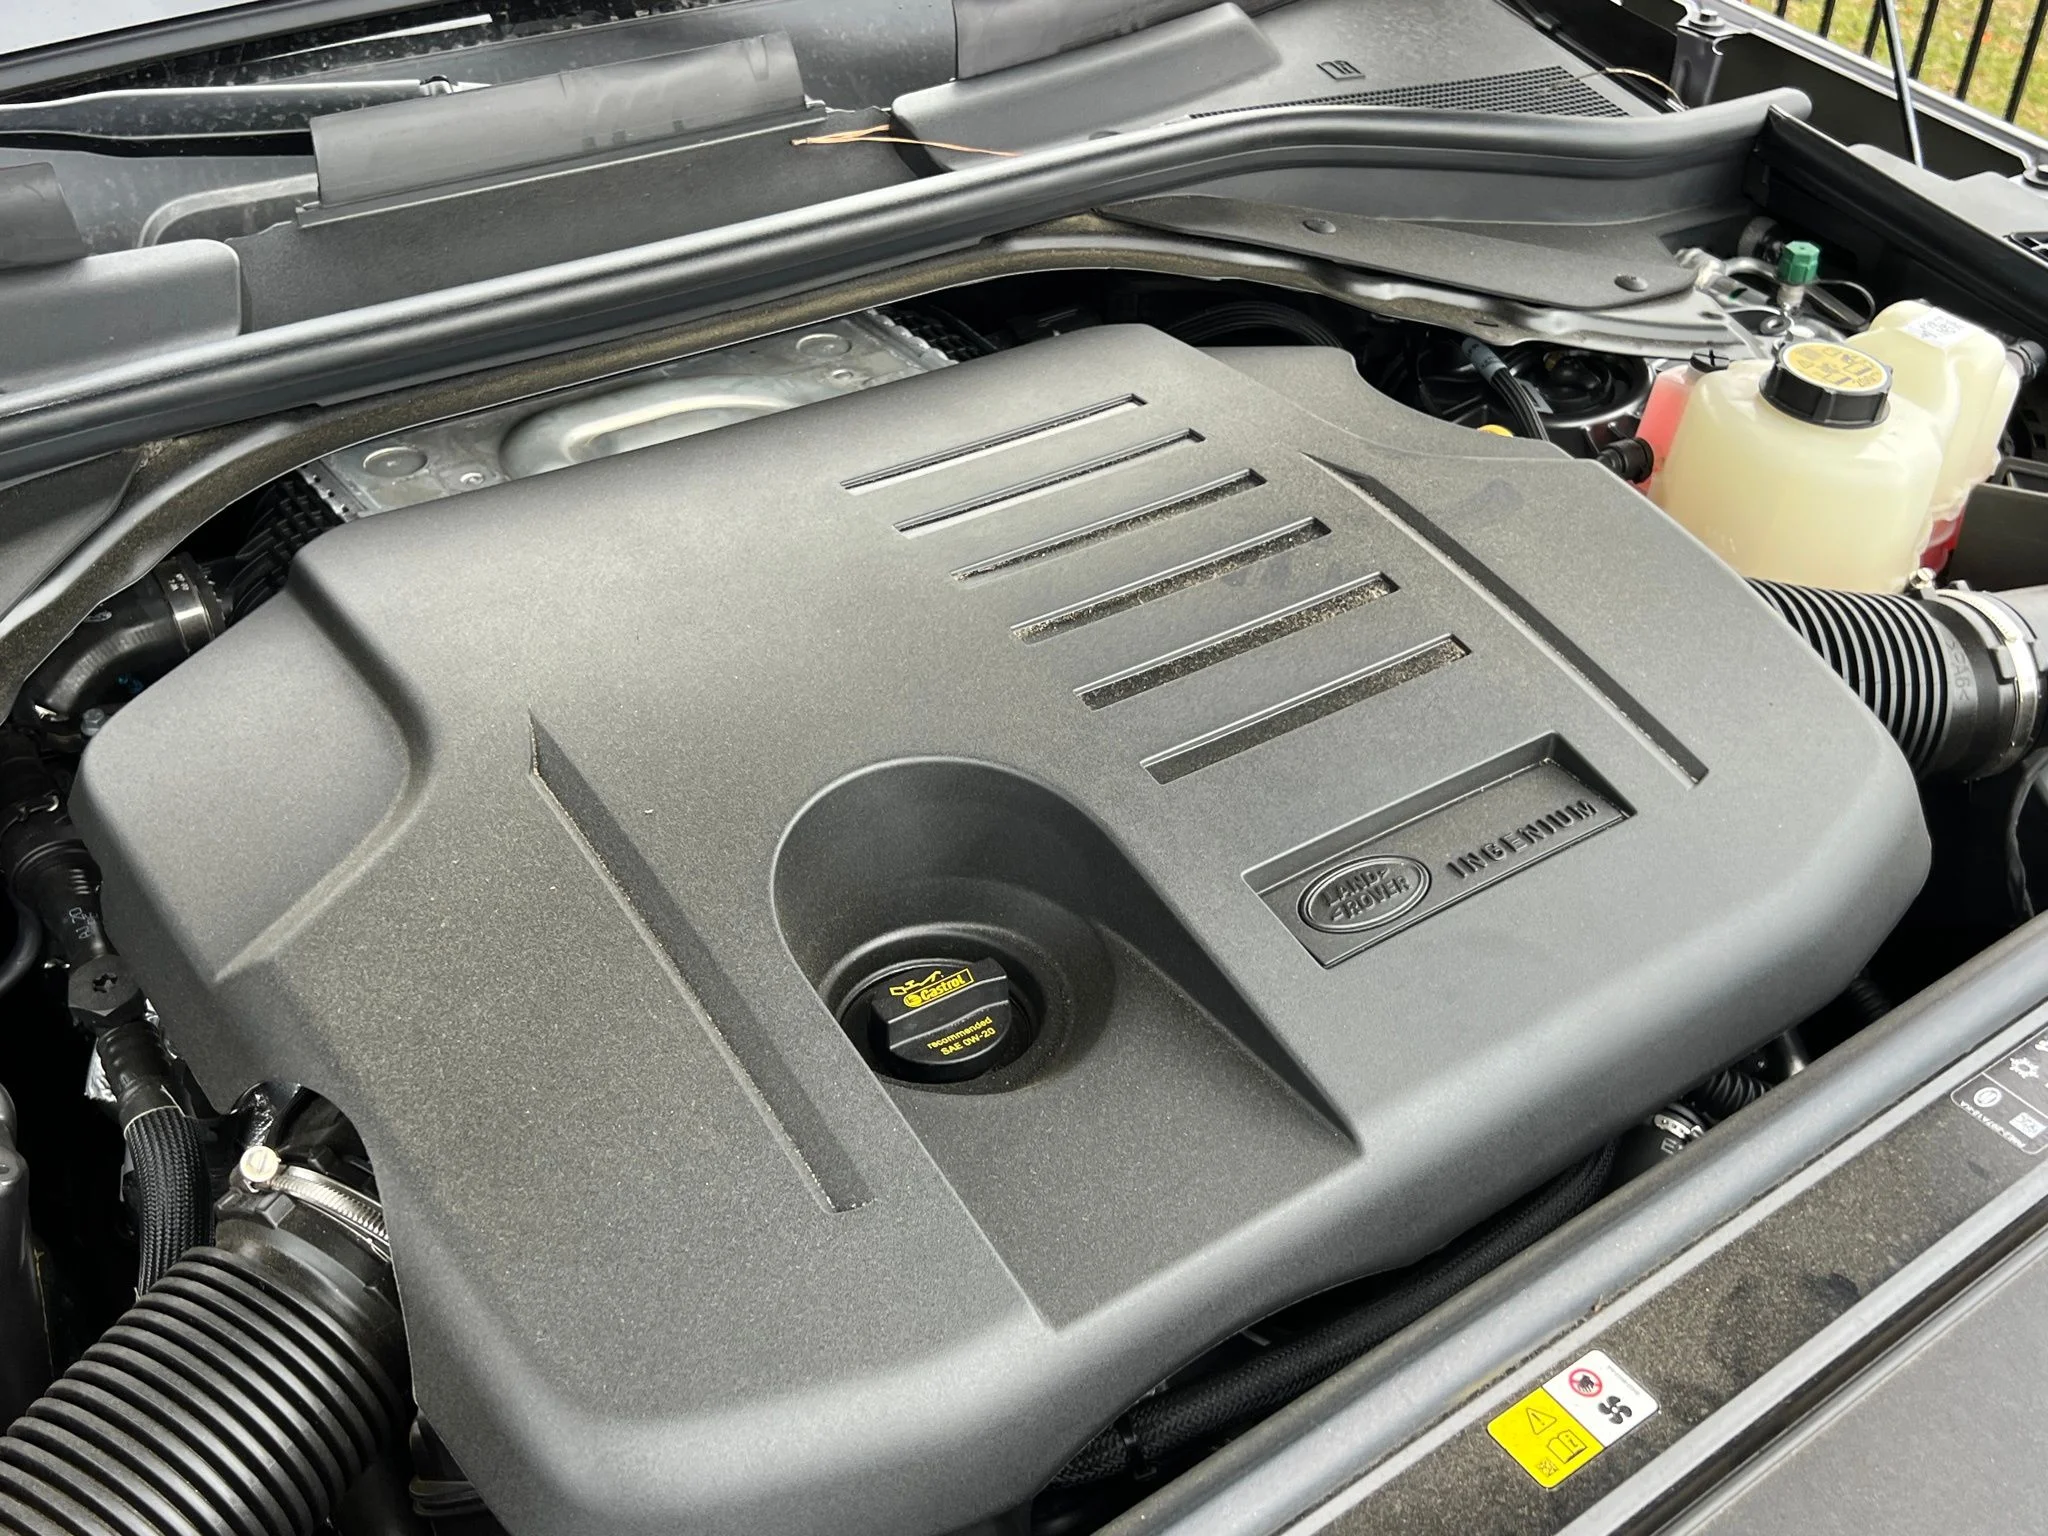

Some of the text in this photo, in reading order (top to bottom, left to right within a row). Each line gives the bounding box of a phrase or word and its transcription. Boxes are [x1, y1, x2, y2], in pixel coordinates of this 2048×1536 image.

[1448, 800, 1597, 879] INGENIUM
[1323, 872, 1383, 905] LAND
[1344, 876, 1412, 920] ROVER
[922, 975, 966, 1001] Castrol
[928, 1016, 993, 1050] recommended
[940, 1028, 996, 1056] SAE 0W-20
